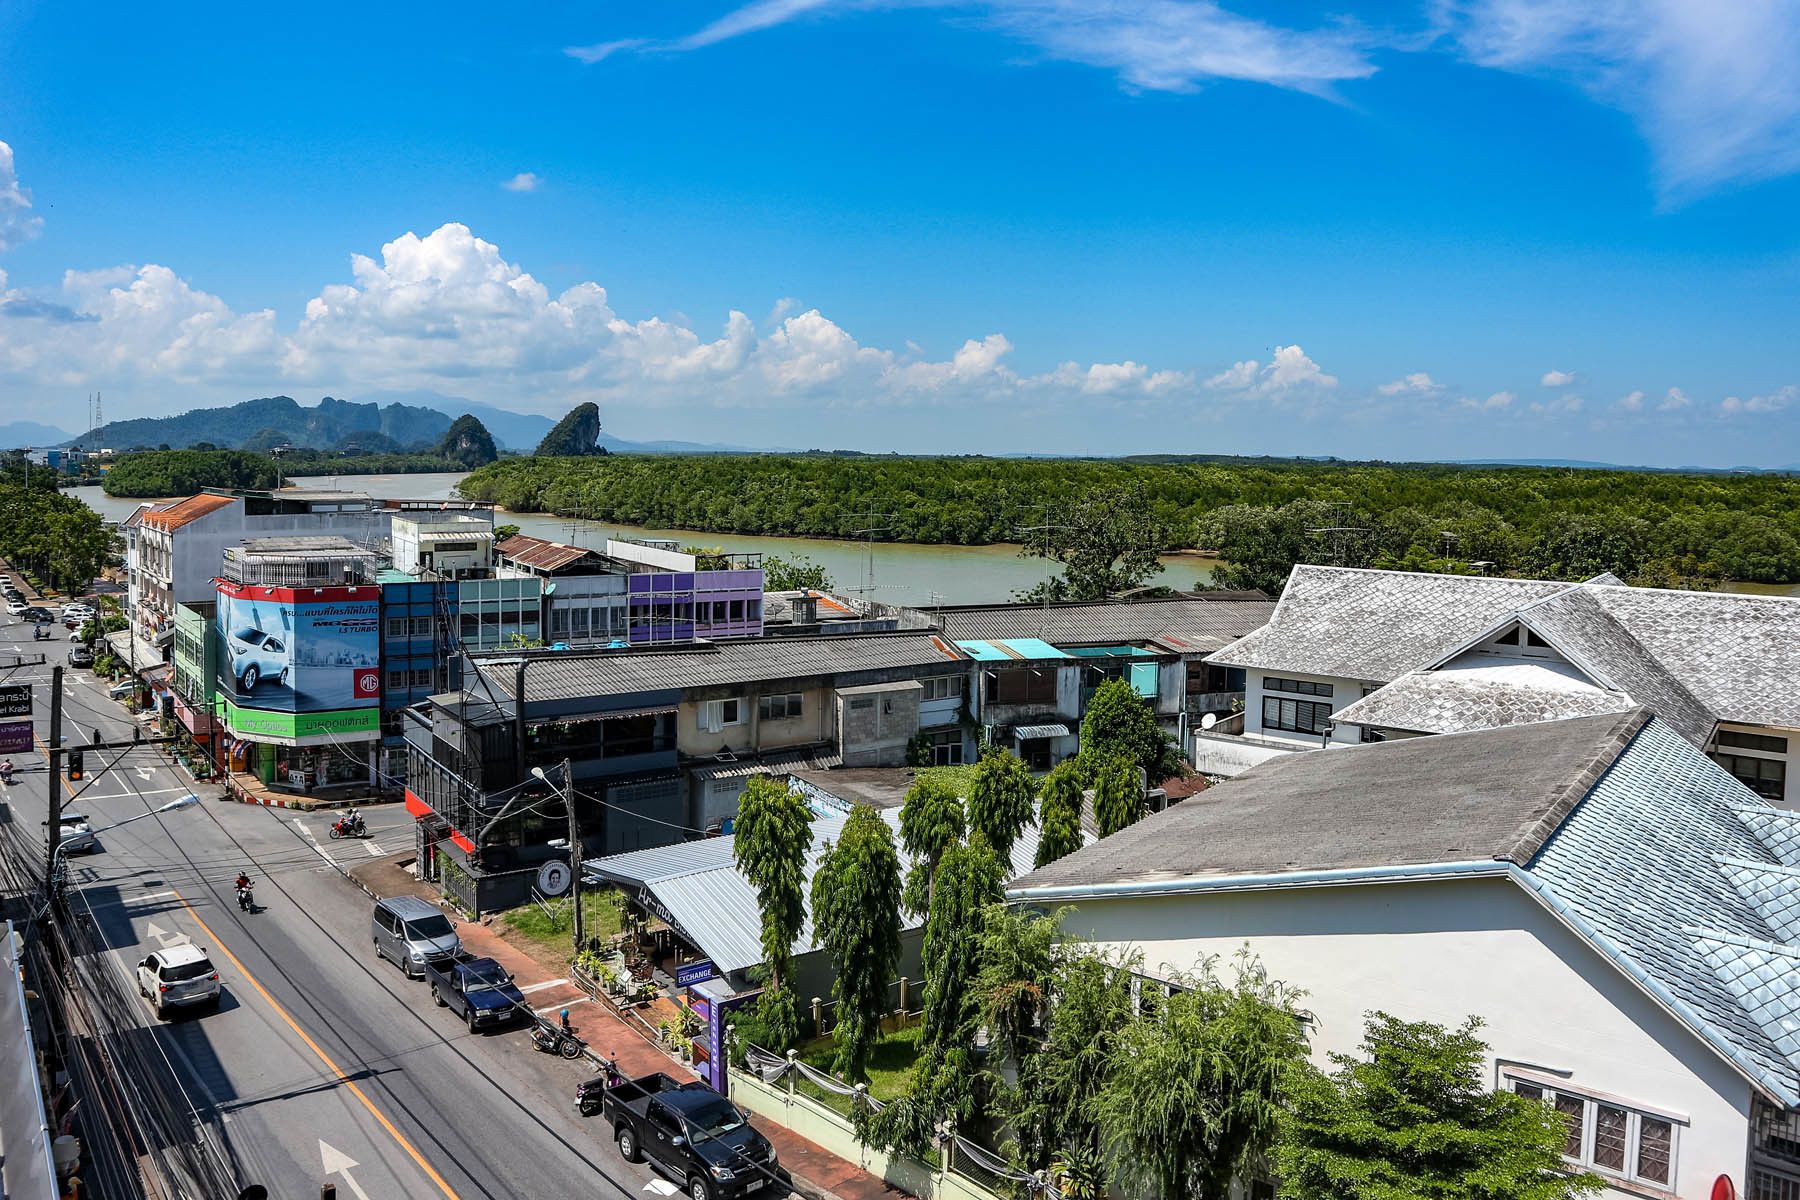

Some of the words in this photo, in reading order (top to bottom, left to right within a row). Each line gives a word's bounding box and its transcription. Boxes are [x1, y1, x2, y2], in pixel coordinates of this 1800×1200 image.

[362, 676, 377, 690] MG
[9, 704, 30, 713] Krabi
[678, 968, 712, 984] EXCHANGE
